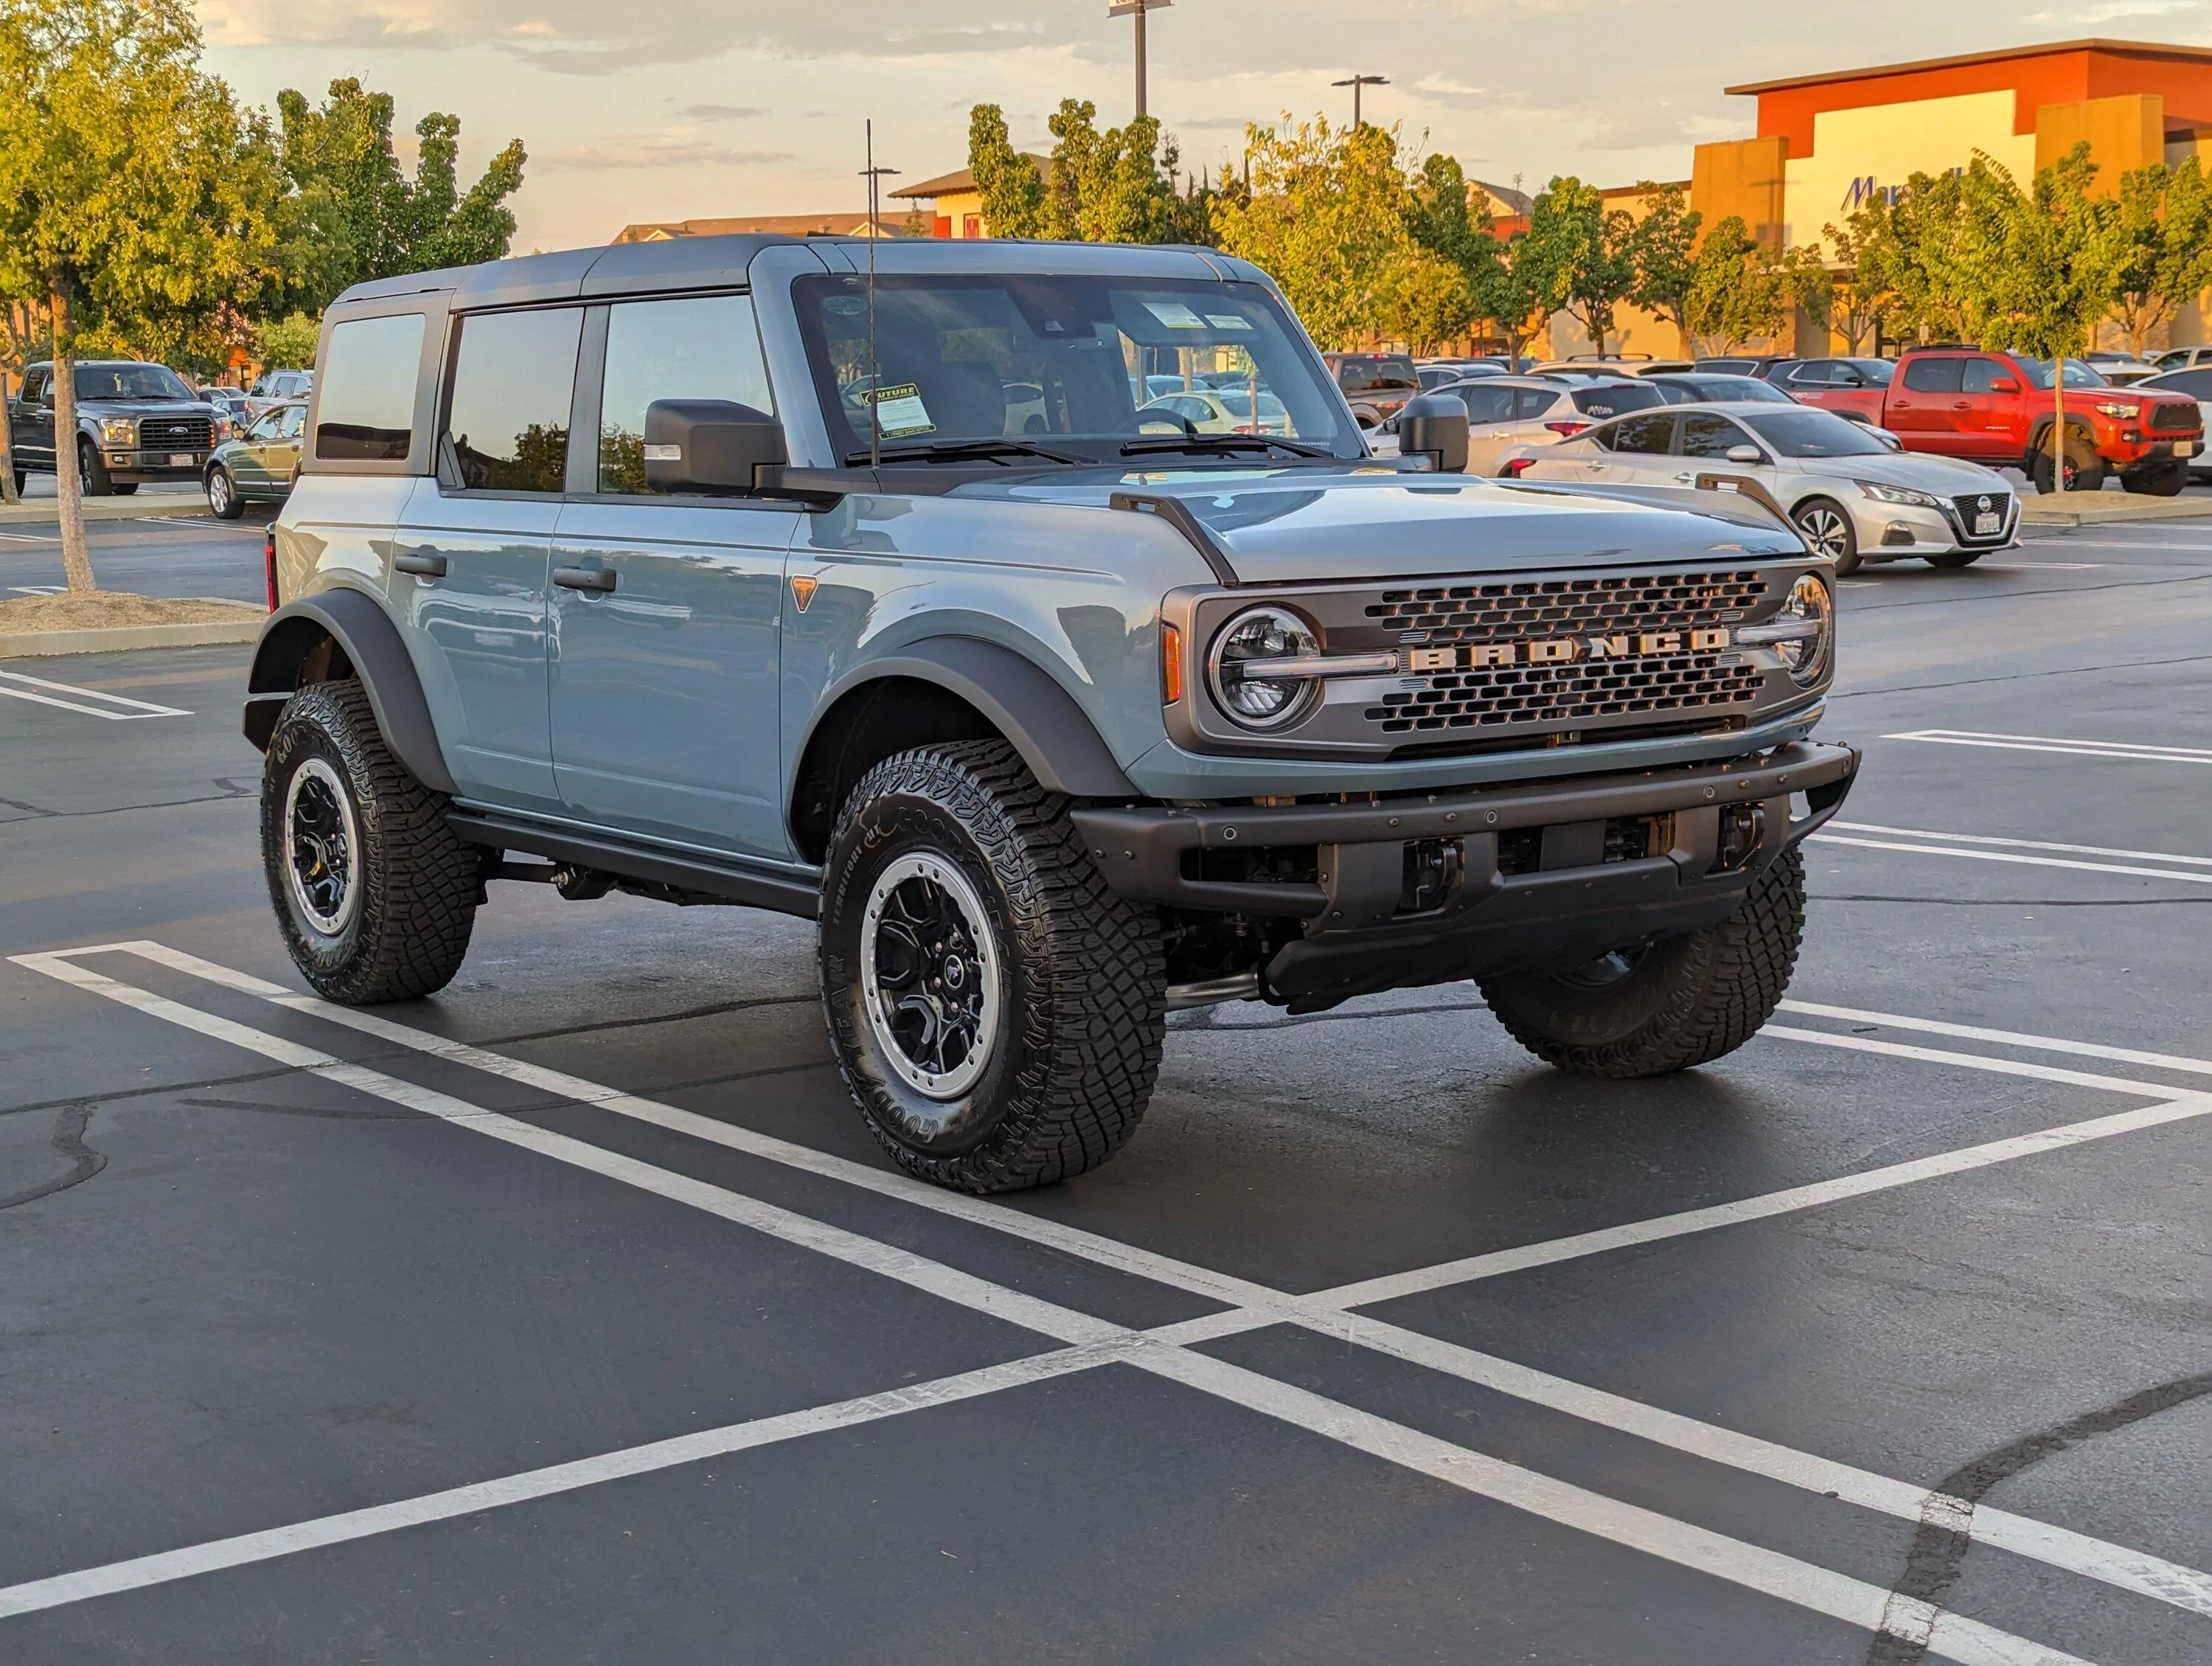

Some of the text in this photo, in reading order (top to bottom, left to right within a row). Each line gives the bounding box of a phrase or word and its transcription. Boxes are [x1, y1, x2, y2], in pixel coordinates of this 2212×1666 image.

[1410, 626, 1730, 672] BRONCO
[832, 843, 863, 926] TERRITORY
[827, 954, 940, 1144] GOODYEAR
